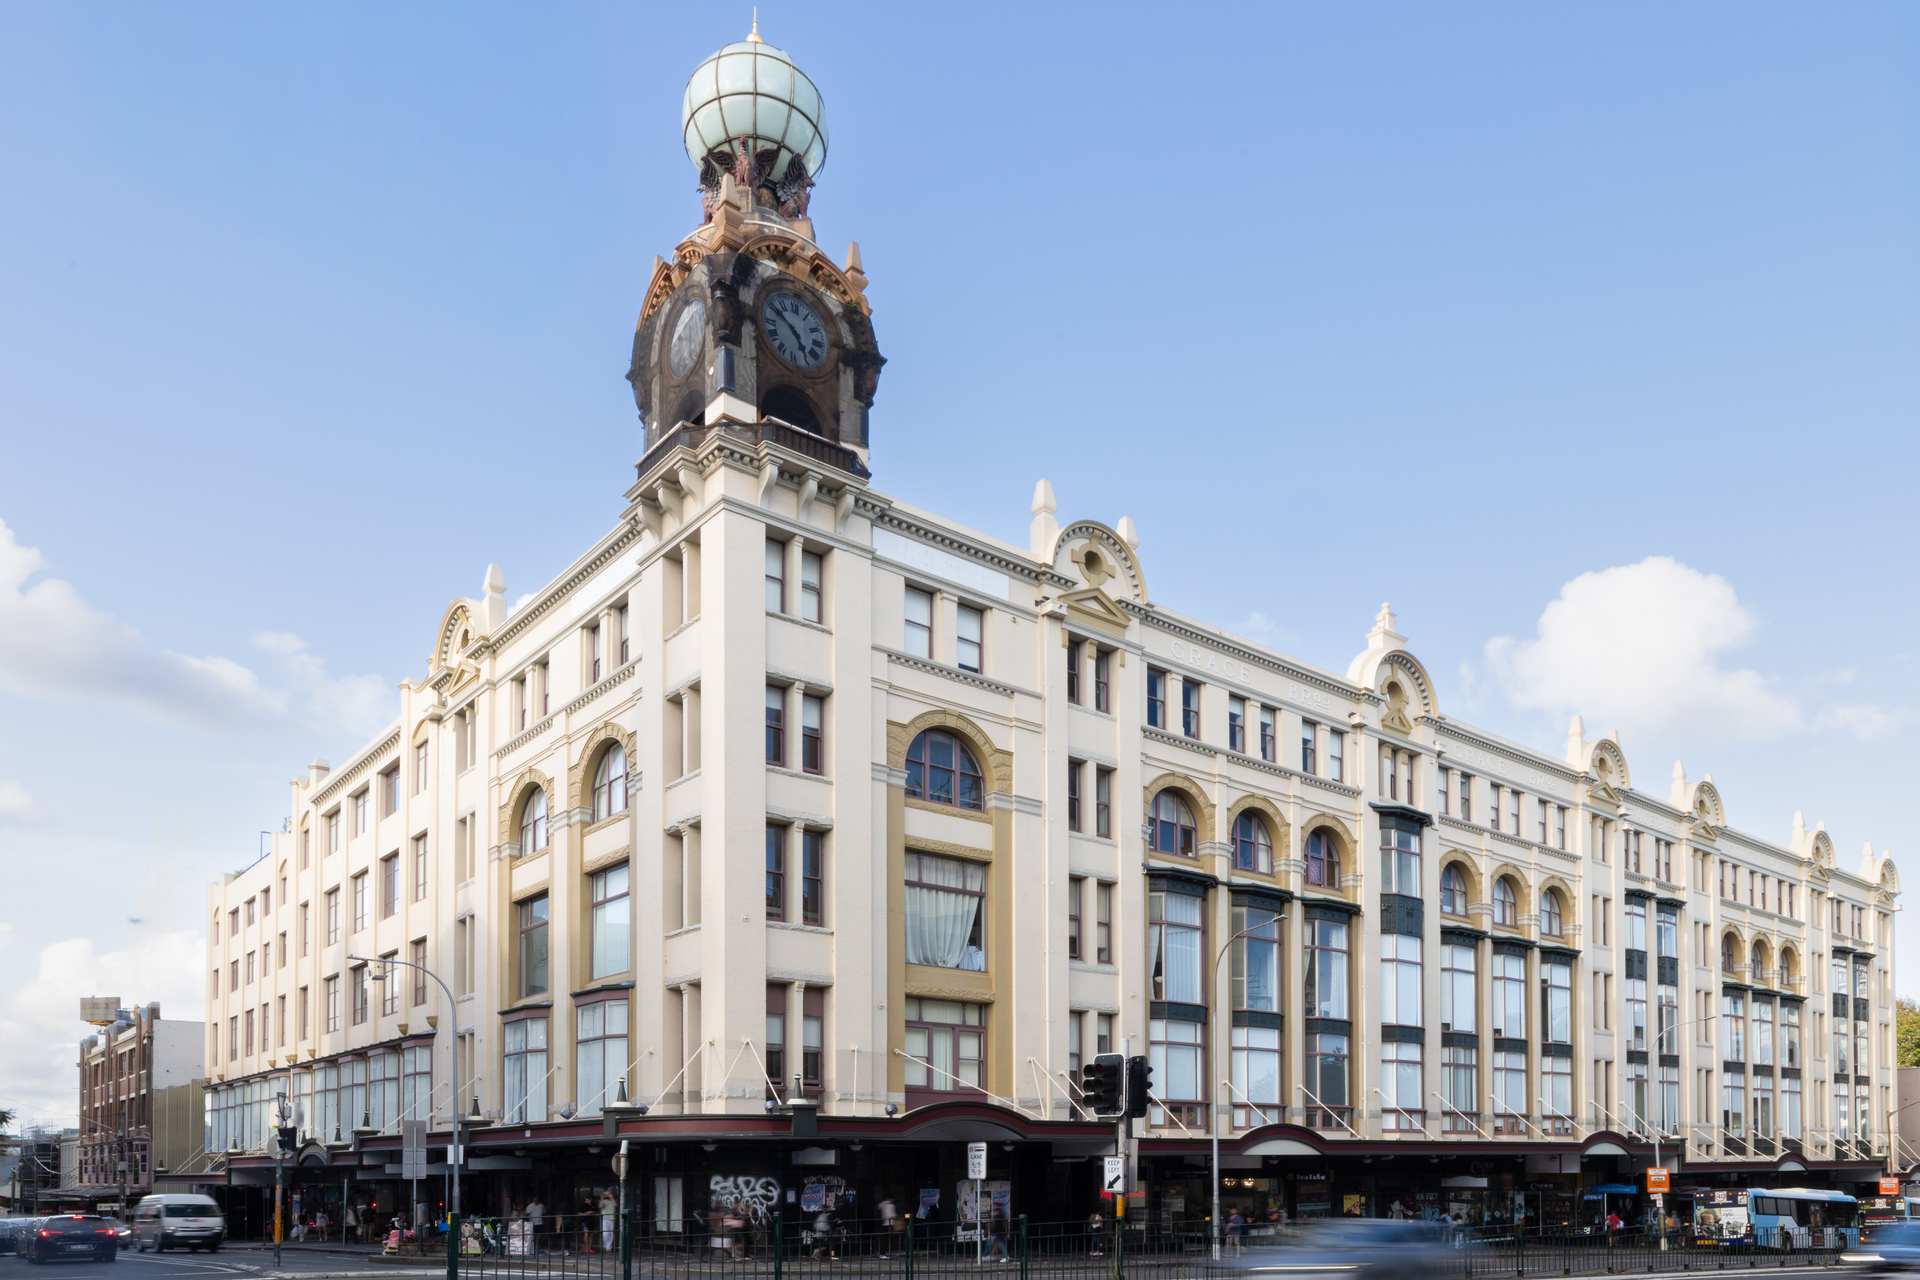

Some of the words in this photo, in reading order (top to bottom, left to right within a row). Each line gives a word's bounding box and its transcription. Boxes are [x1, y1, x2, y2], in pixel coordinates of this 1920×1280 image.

[1171, 640, 1250, 684] GRACE
[1453, 743, 1506, 775] GRACE
[1623, 804, 1656, 828] RACE
[1727, 843, 1756, 862] GRACE
[1530, 1183, 1554, 1191] Crown
